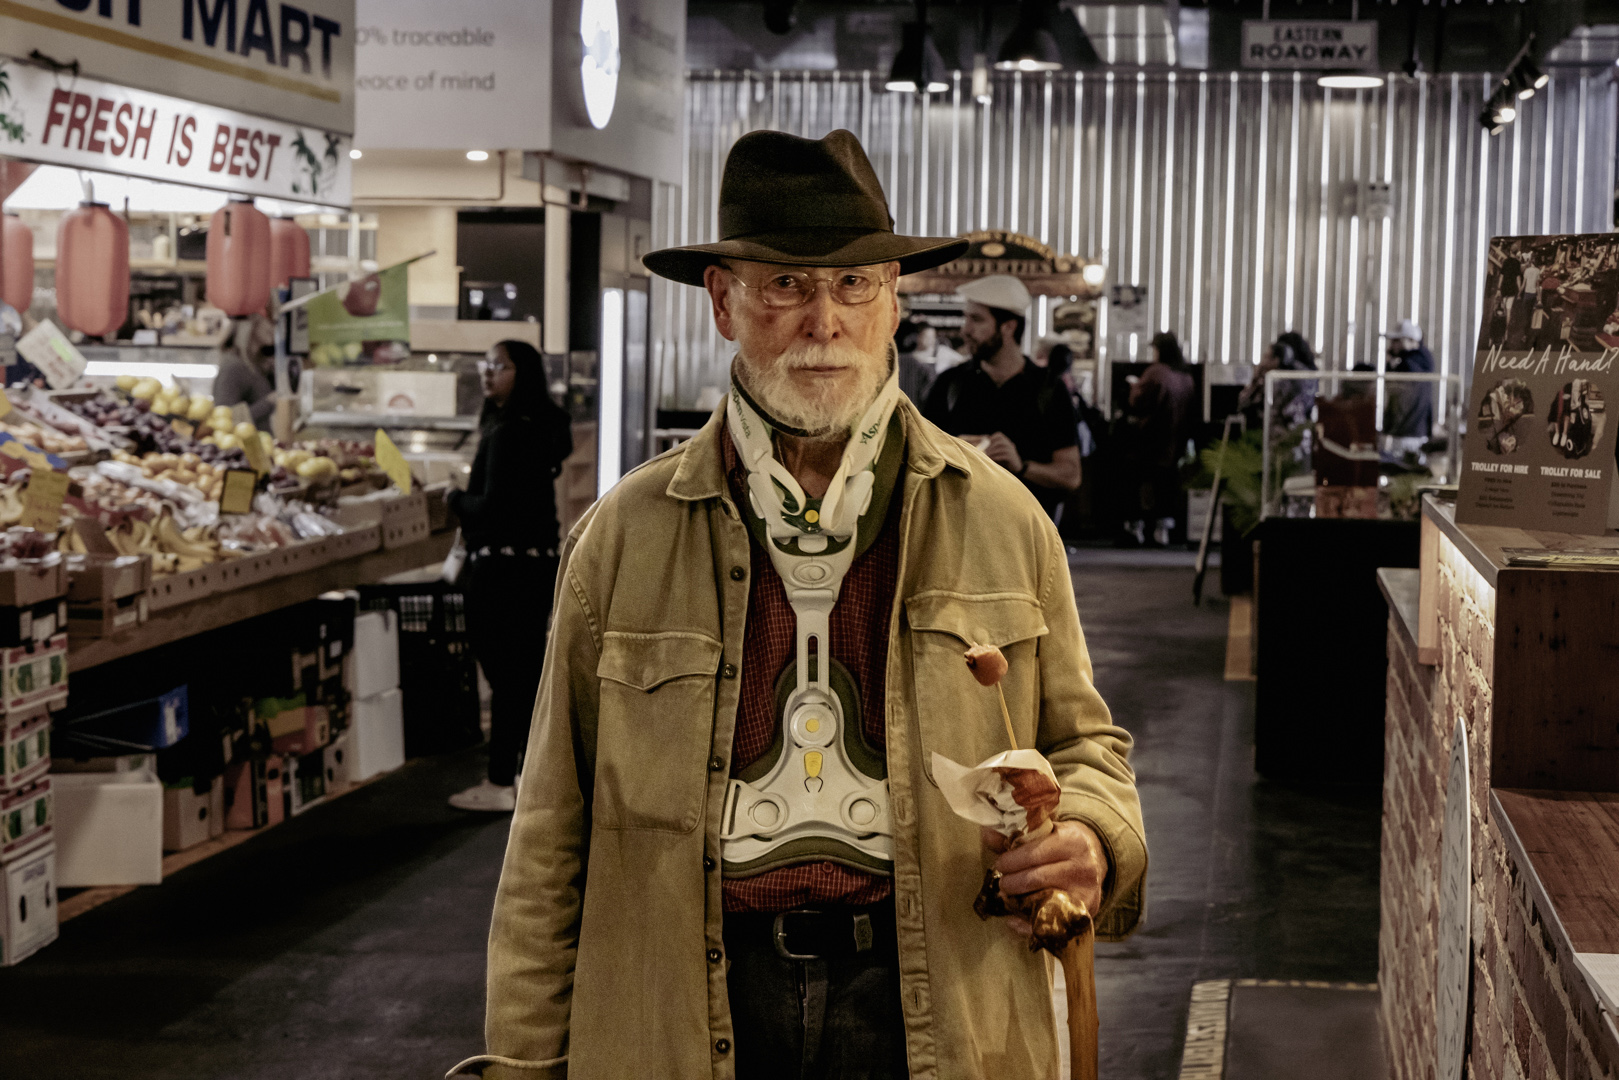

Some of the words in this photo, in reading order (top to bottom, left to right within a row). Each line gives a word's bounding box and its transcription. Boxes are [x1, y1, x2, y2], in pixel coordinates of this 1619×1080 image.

[182, 0, 341, 79] MART
[355, 26, 388, 46] 0%
[391, 26, 495, 47] traceable
[1274, 27, 1342, 41] EASTERN
[1251, 45, 1365, 59] ROADWAY
[355, 74, 409, 91] eace
[413, 70, 438, 91] of
[440, 71, 496, 91] mind
[41, 87, 158, 161] FRESH
[165, 113, 198, 168] IS
[207, 123, 283, 182] BEST
[1481, 343, 1536, 374] Need
[1533, 343, 1552, 375] A
[1553, 344, 1619, 375] Hand?
[1471, 461, 1499, 473] TROLLEY
[1499, 464, 1514, 474] FOR
[1513, 464, 1530, 475] HIRE
[1540, 466, 1569, 477] TROLLEY
[1569, 468, 1584, 478] FOR
[1584, 469, 1602, 480] SALE
